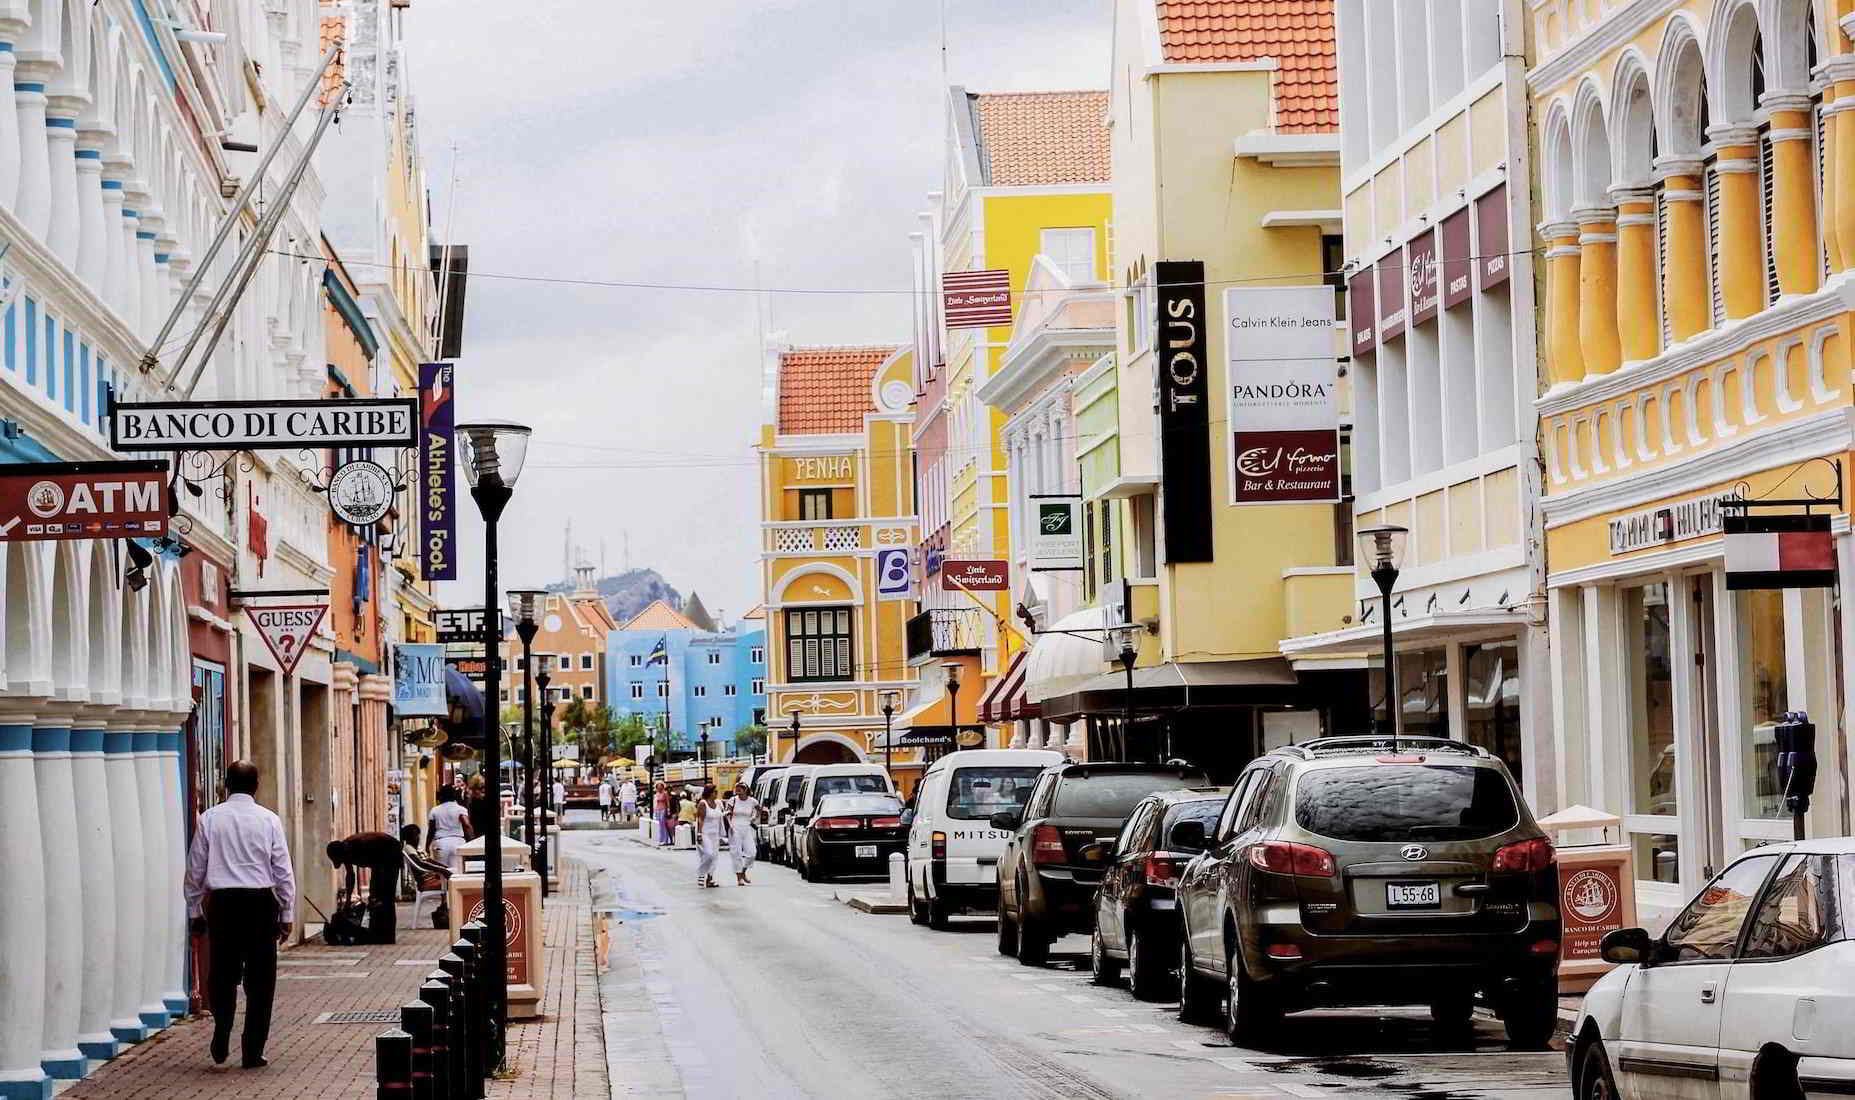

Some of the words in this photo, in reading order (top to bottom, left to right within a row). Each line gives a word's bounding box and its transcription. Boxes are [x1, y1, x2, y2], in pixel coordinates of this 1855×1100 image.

[1231, 316, 1267, 328] Calvin
[1270, 316, 1297, 328] Klein
[1300, 316, 1332, 328] Jeans
[1167, 298, 1198, 412] TOUS
[442, 366, 451, 383] The
[122, 411, 235, 440] BANCO
[244, 411, 279, 438] DI
[285, 409, 408, 438] CARIBE
[428, 432, 447, 522] Athlete's
[793, 456, 853, 480] PENHA
[1243, 480, 1264, 491] Bar
[1264, 479, 1275, 491] &
[1275, 479, 1331, 490] Restaurant
[65, 480, 161, 514] ATM
[1608, 510, 1657, 551] TOMMY
[429, 529, 448, 572] Foot
[954, 574, 1003, 586] Switzerland
[258, 611, 313, 628] GUESS
[900, 736, 952, 745] Boolchand's
[1393, 887, 1400, 902] L
[1402, 887, 1434, 902] 55-68
